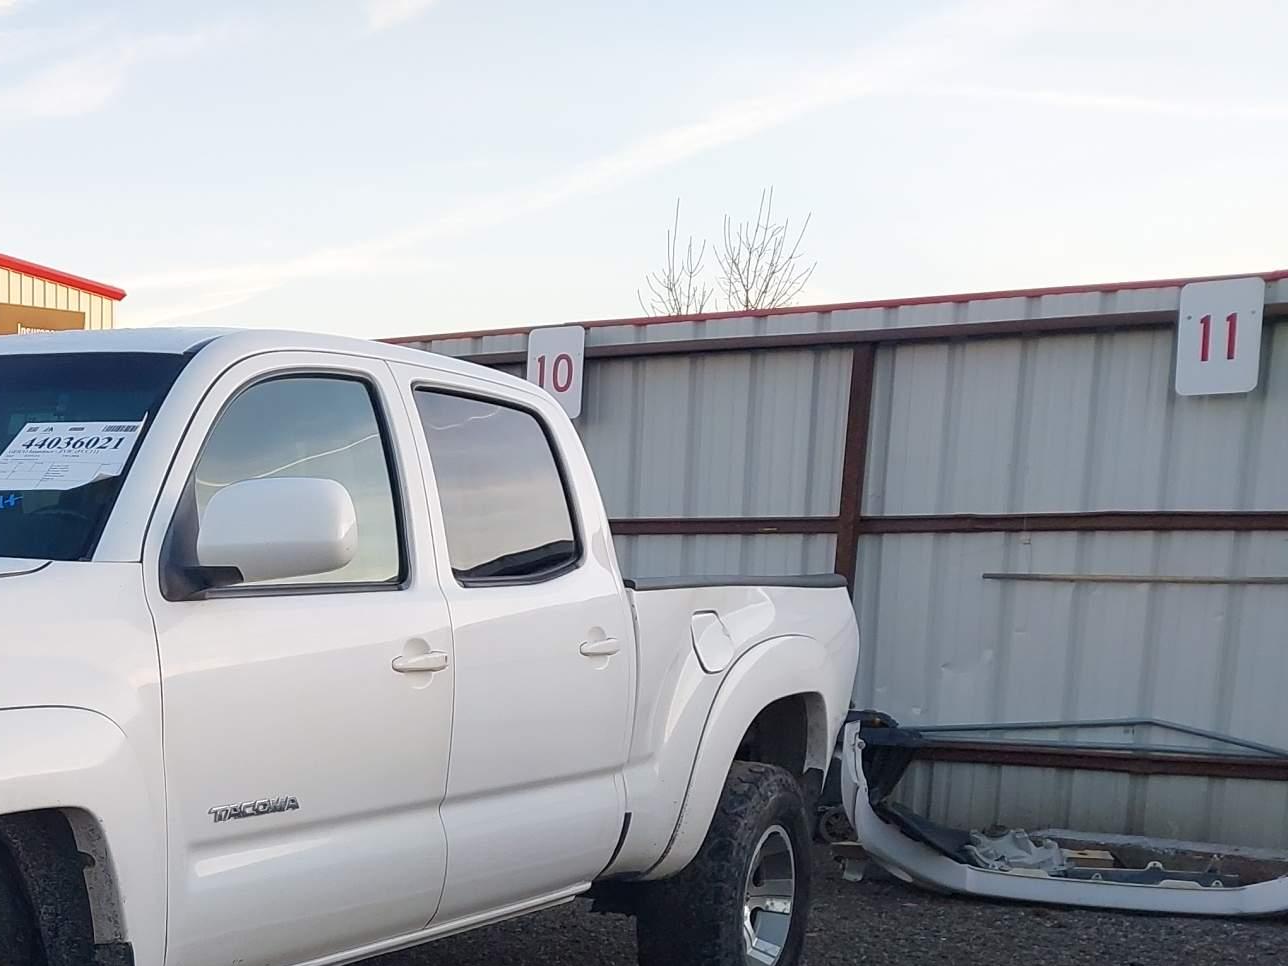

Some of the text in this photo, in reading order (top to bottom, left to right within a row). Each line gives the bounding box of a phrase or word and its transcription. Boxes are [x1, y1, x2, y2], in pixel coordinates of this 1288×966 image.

[1199, 312, 1238, 362] 11
[537, 353, 574, 393] 10
[22, 436, 126, 451] 44036021
[208, 796, 300, 823] TACOMA
